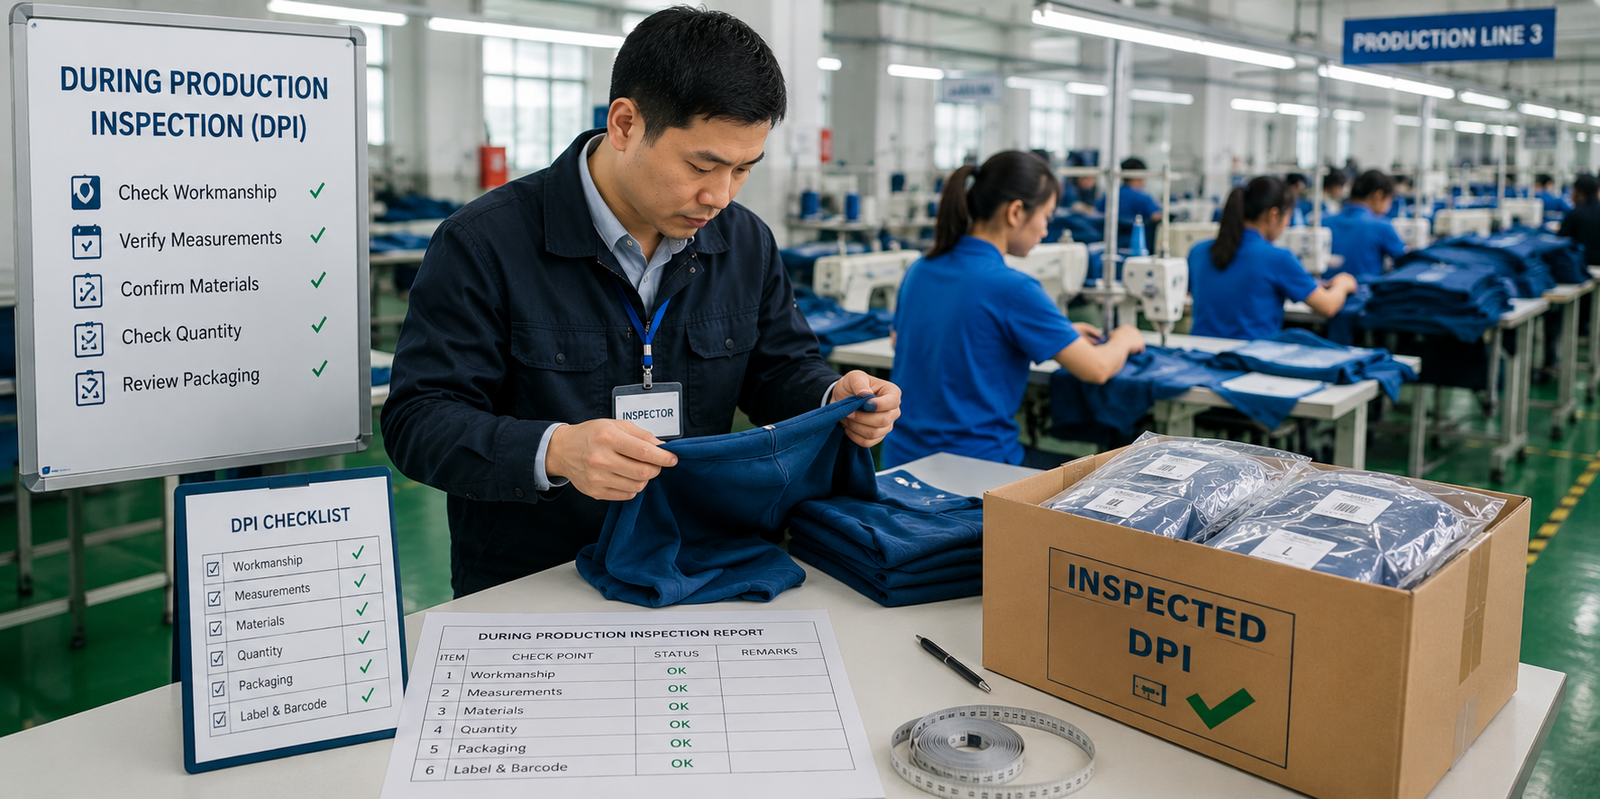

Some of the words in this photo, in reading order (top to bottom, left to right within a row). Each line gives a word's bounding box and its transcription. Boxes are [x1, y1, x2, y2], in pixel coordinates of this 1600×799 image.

[1353, 27, 1476, 53] PRODUCTION
[1481, 24, 1525, 47] LINE
[1529, 23, 1543, 45] 3
[60, 65, 162, 94] DURING
[170, 70, 328, 100] PRODUCTION
[91, 110, 243, 138] INSPECTION
[251, 112, 307, 143] (DPI)
[118, 183, 169, 201] Check
[173, 183, 277, 203] Workmanship
[119, 231, 166, 252] Verify
[171, 230, 283, 248] Measurements
[120, 279, 185, 298] Confirm
[190, 275, 260, 294] Materials
[121, 326, 172, 345] Check
[176, 323, 242, 343] Quantity
[123, 373, 179, 393] Review
[183, 367, 260, 389] Packaging
[622, 408, 674, 420] INSPECTOR
[231, 516, 258, 533] DPI
[263, 506, 351, 530] CHECKLIST
[232, 555, 303, 572] Workmanship
[234, 583, 311, 602] Measurements
[1068, 563, 1266, 644] INSPECTED
[236, 615, 285, 631] Materials
[478, 631, 532, 641] DURING
[536, 630, 626, 641] PRODUCTION
[629, 629, 710, 639] INSPECTION
[713, 627, 764, 638] REPORT
[237, 646, 283, 662] Quantity
[511, 652, 553, 661] CHECK
[556, 651, 594, 660] POINT
[654, 649, 700, 659] STATUS
[741, 647, 798, 657] REMARKS
[1129, 627, 1191, 673] DPI
[439, 653, 465, 662] ITEM
[445, 671, 453, 680] 1
[470, 669, 556, 681] Workmanship
[666, 666, 687, 675] OK
[238, 674, 294, 692] Packaging
[667, 684, 688, 693] OK
[441, 688, 450, 698] 2
[467, 687, 563, 697] Measurements
[240, 706, 269, 722] Label
[272, 705, 281, 717] &
[283, 698, 327, 715] Barcode
[437, 706, 446, 716] 3
[463, 705, 524, 716] Materials
[668, 702, 690, 712] OK
[433, 725, 442, 734] 4
[460, 724, 518, 736] Quantity
[669, 719, 691, 729] OK
[429, 744, 439, 754] 5
[457, 742, 527, 755] Packaging
[670, 738, 692, 748] OK
[453, 763, 492, 775] Label
[495, 763, 507, 774] &
[511, 762, 568, 773] Barcode
[671, 758, 694, 769] OK
[425, 765, 435, 775] 6
